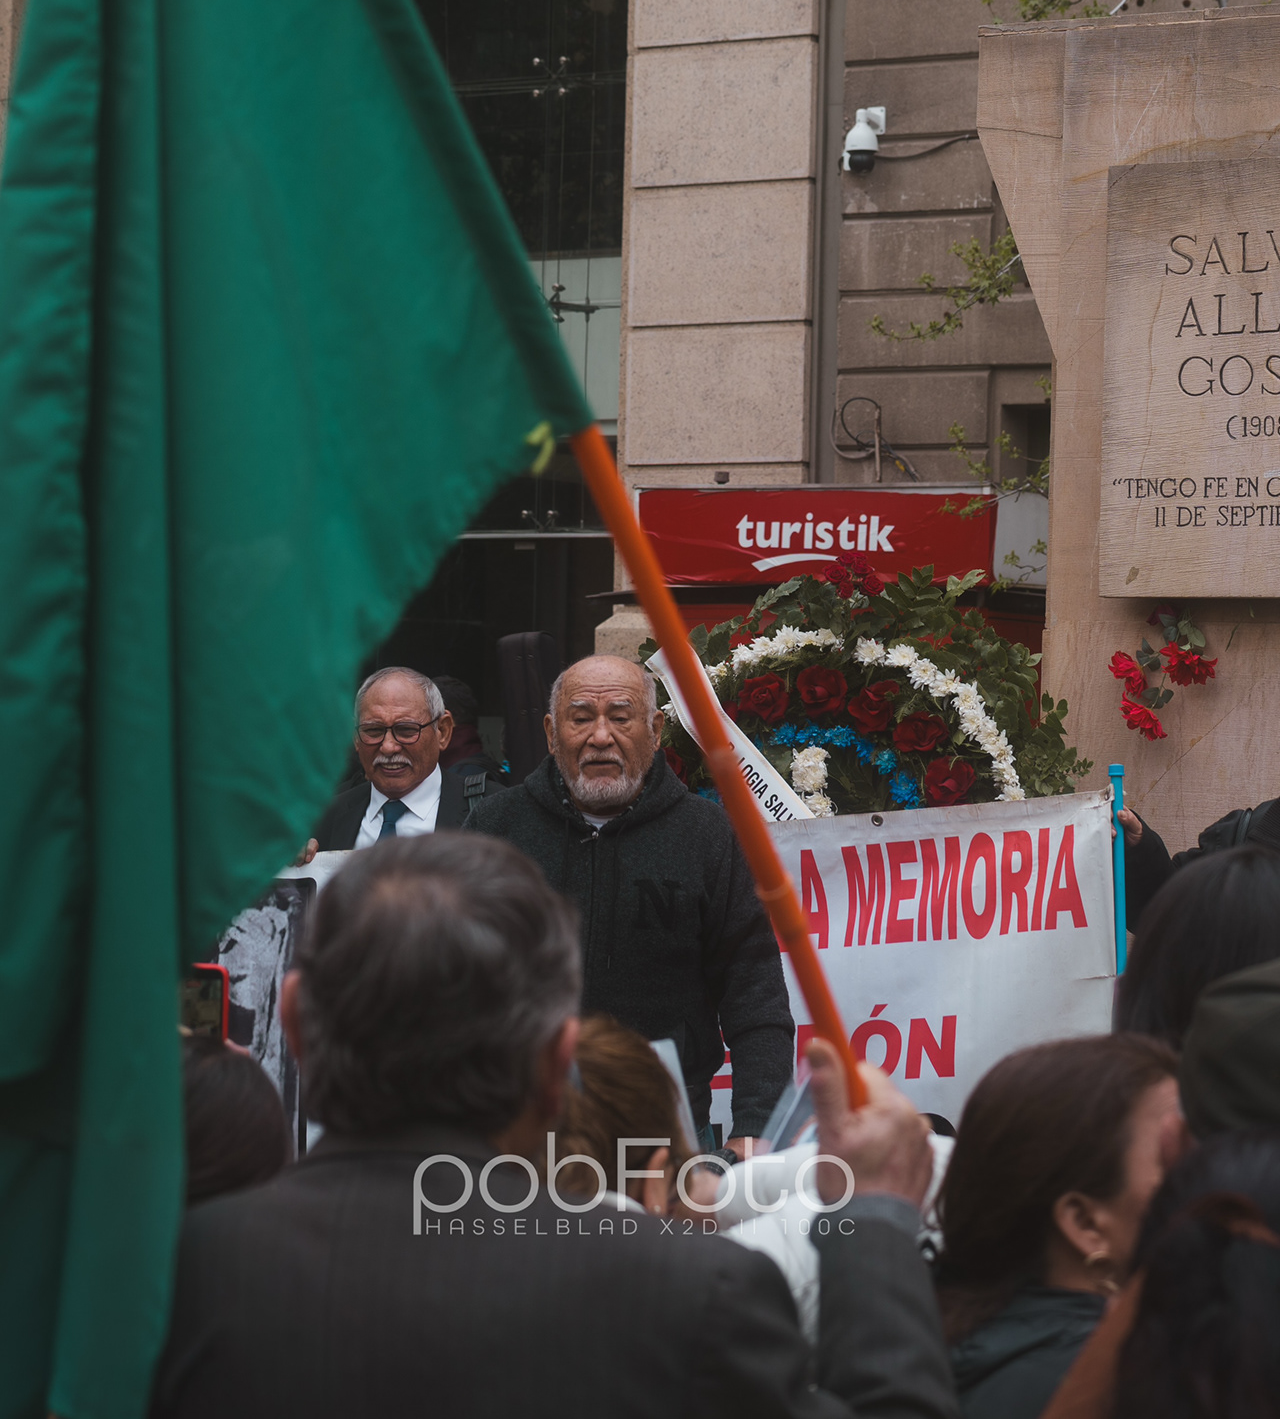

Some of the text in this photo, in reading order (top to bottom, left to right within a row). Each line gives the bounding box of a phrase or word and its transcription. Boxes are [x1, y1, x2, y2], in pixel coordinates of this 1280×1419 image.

[1203, 477, 1228, 498] FE
[1235, 476, 1259, 498] EN
[1176, 506, 1207, 527] DE
[735, 512, 895, 553] turistik
[840, 824, 1089, 948] MEMORIA
